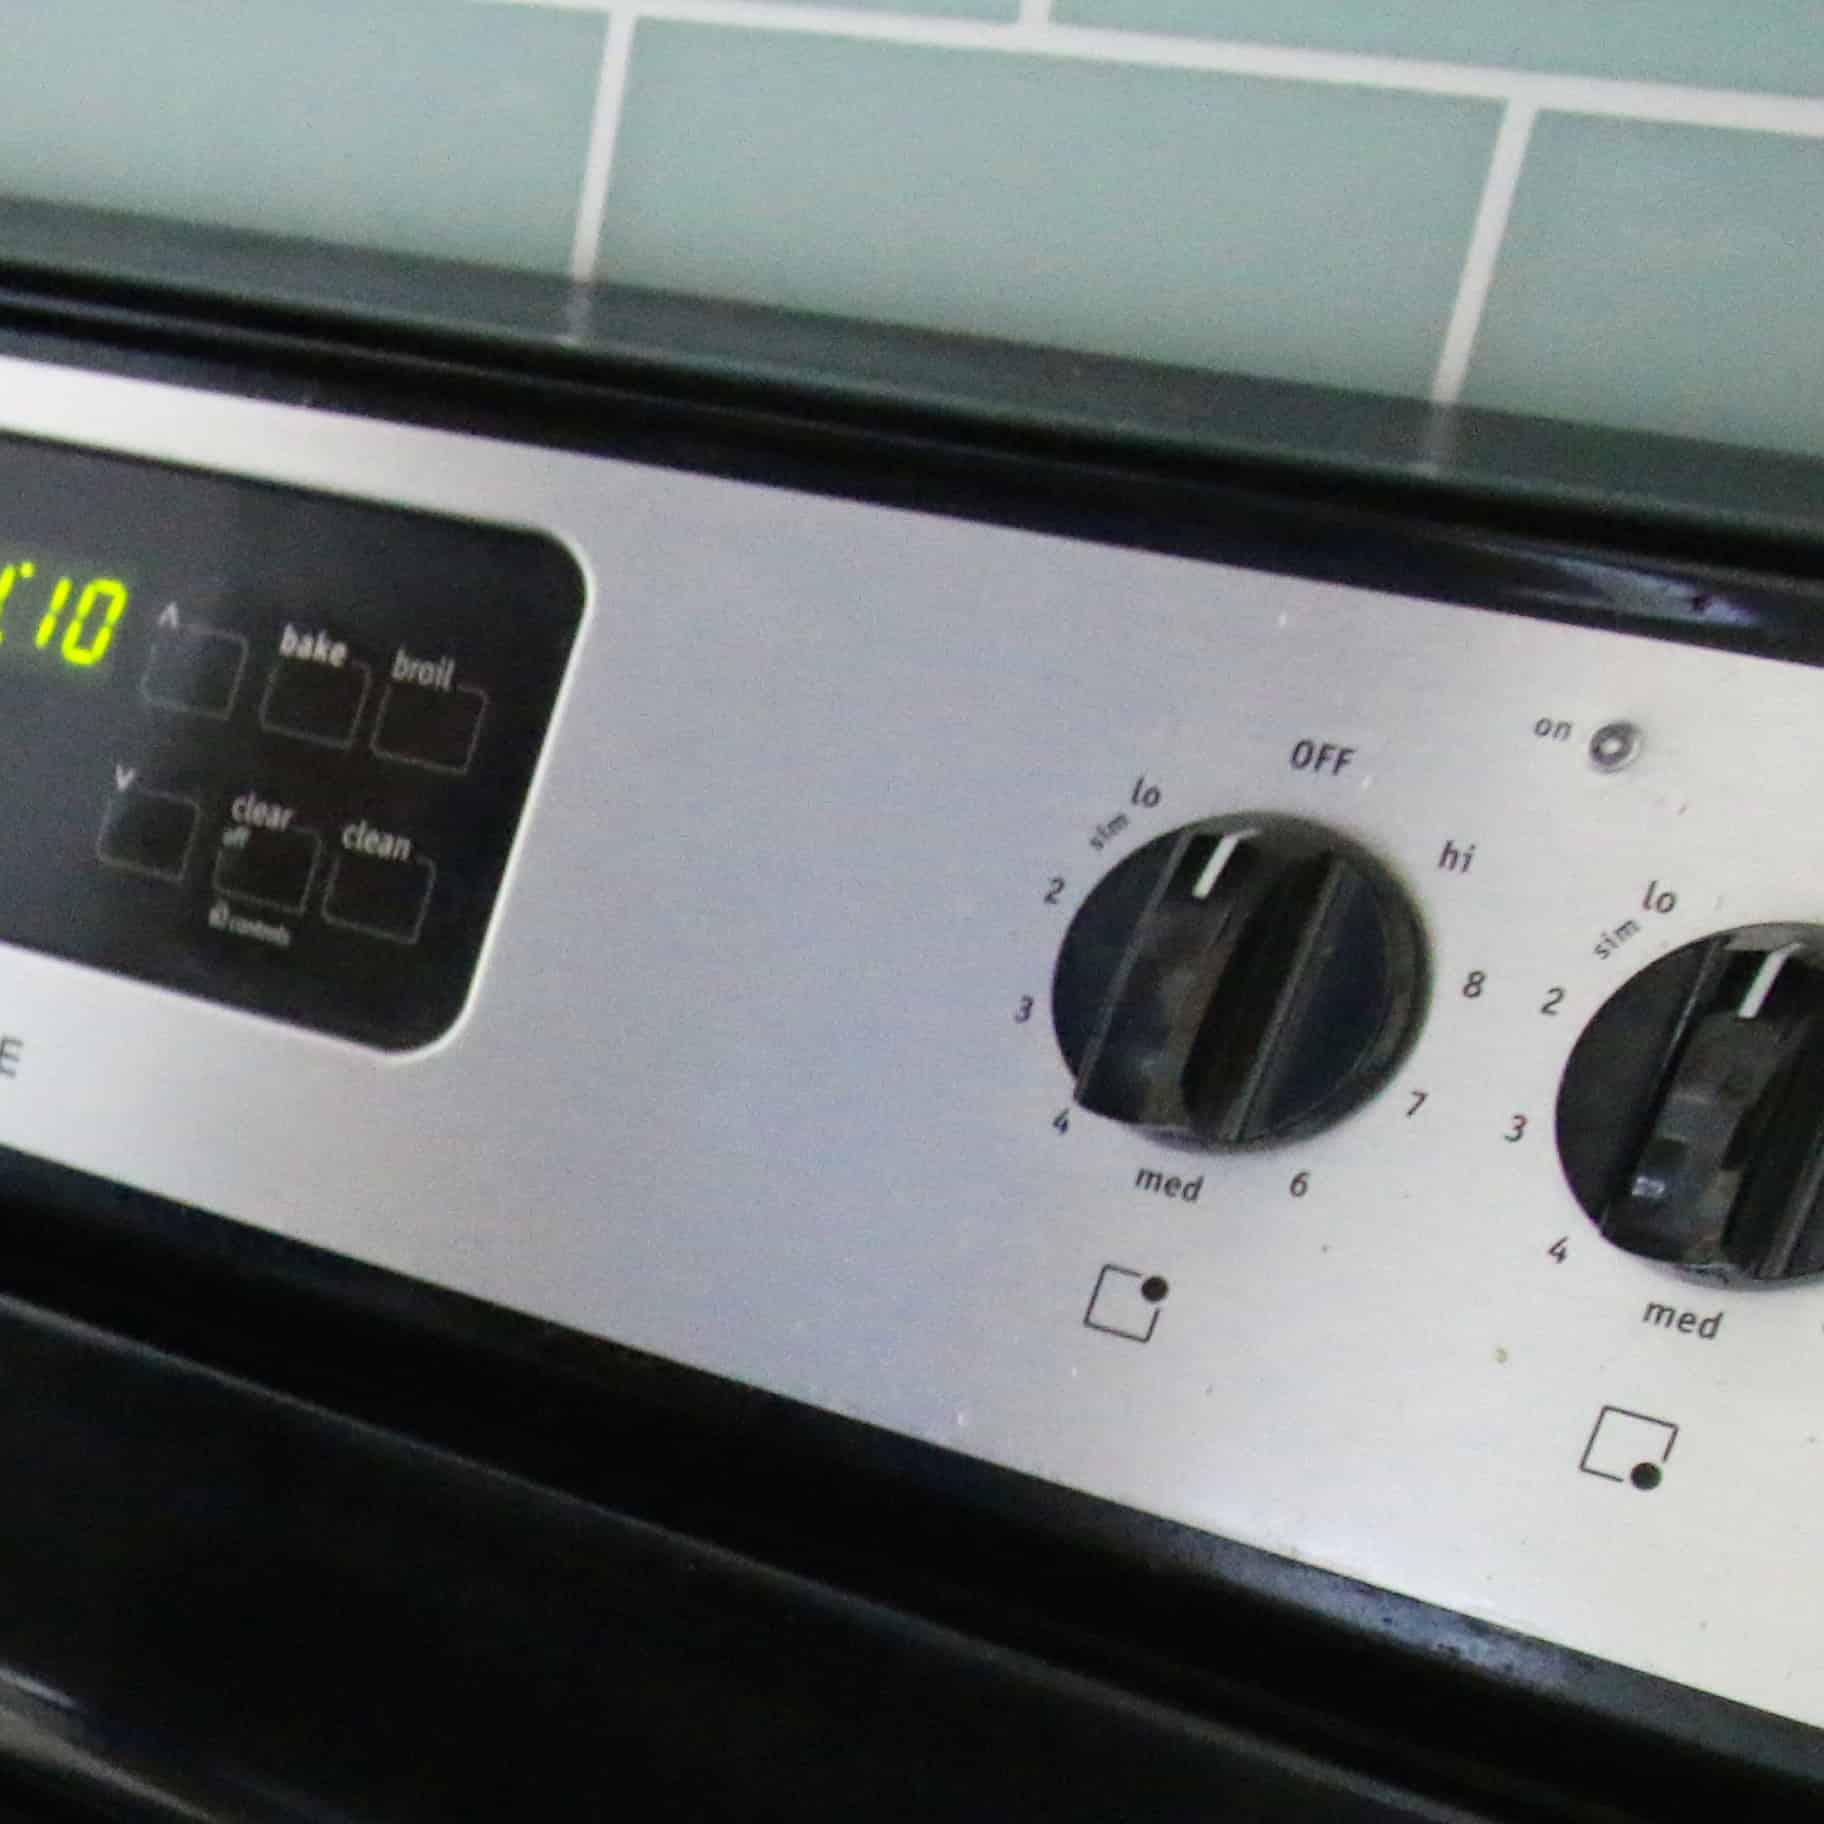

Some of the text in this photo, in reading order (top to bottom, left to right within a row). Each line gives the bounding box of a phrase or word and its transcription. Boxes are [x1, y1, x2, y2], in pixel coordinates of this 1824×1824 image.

[279, 623, 348, 669] bake
[390, 644, 456, 692] broil
[1533, 717, 1573, 742] on
[1289, 739, 1357, 777] OFF
[1130, 776, 1164, 809] lo
[231, 792, 295, 831] clear
[340, 820, 412, 862] clean
[1088, 811, 1130, 851] sim
[1437, 840, 1477, 874] hi
[1044, 876, 1066, 905] 2
[1641, 880, 1678, 914] lo
[1593, 917, 1641, 962] sim
[1462, 970, 1487, 999] 8
[1013, 996, 1034, 1024] 3
[1541, 987, 1566, 1017] 2
[1405, 1090, 1428, 1119] 7
[1052, 1107, 1072, 1136] 4
[1503, 1114, 1527, 1144] 3
[1134, 1167, 1205, 1203] med
[1289, 1171, 1310, 1199] 6
[1547, 1235, 1570, 1265] 4
[1642, 1300, 1725, 1340] med
